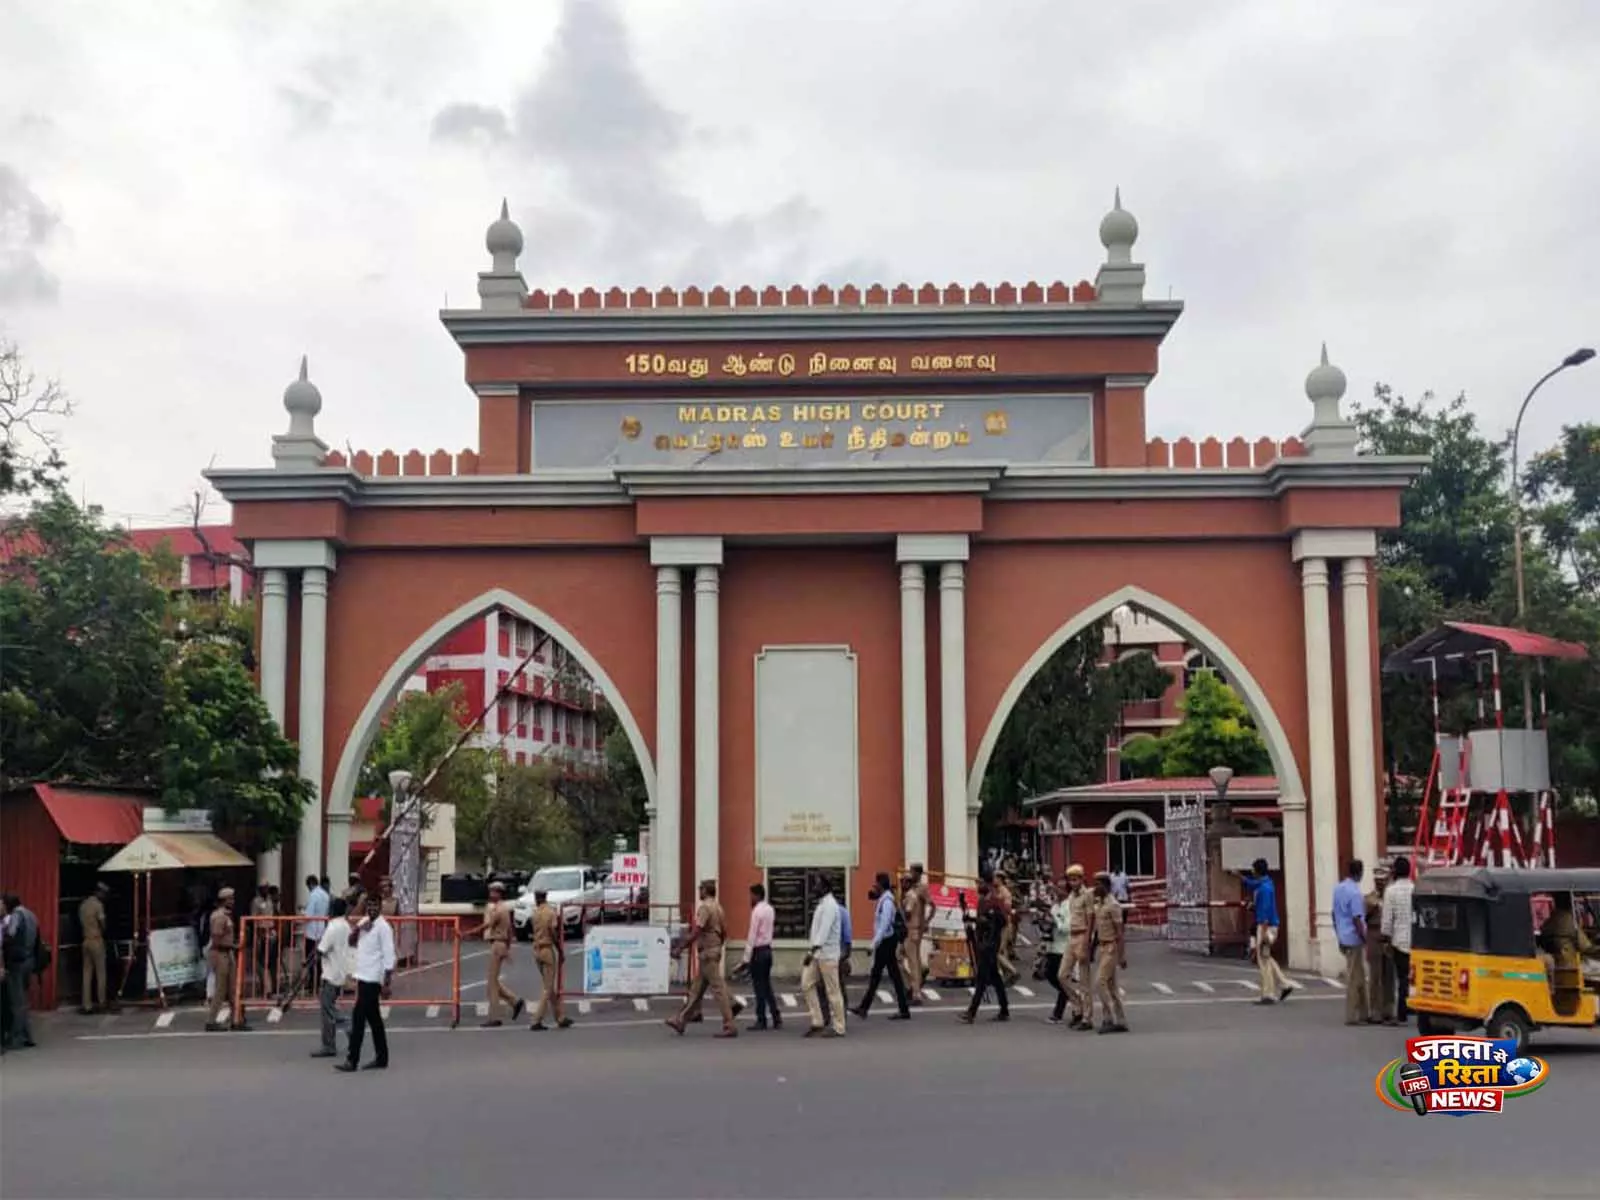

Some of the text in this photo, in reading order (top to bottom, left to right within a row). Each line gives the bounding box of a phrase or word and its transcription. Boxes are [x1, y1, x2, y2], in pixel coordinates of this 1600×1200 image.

[625, 352, 996, 378] 150வது ஆண்டு நினைவு வளைவு
[678, 402, 945, 423] MADRAS HIGH COURT
[623, 857, 638, 868] NO
[613, 872, 646, 884] ENTRY
